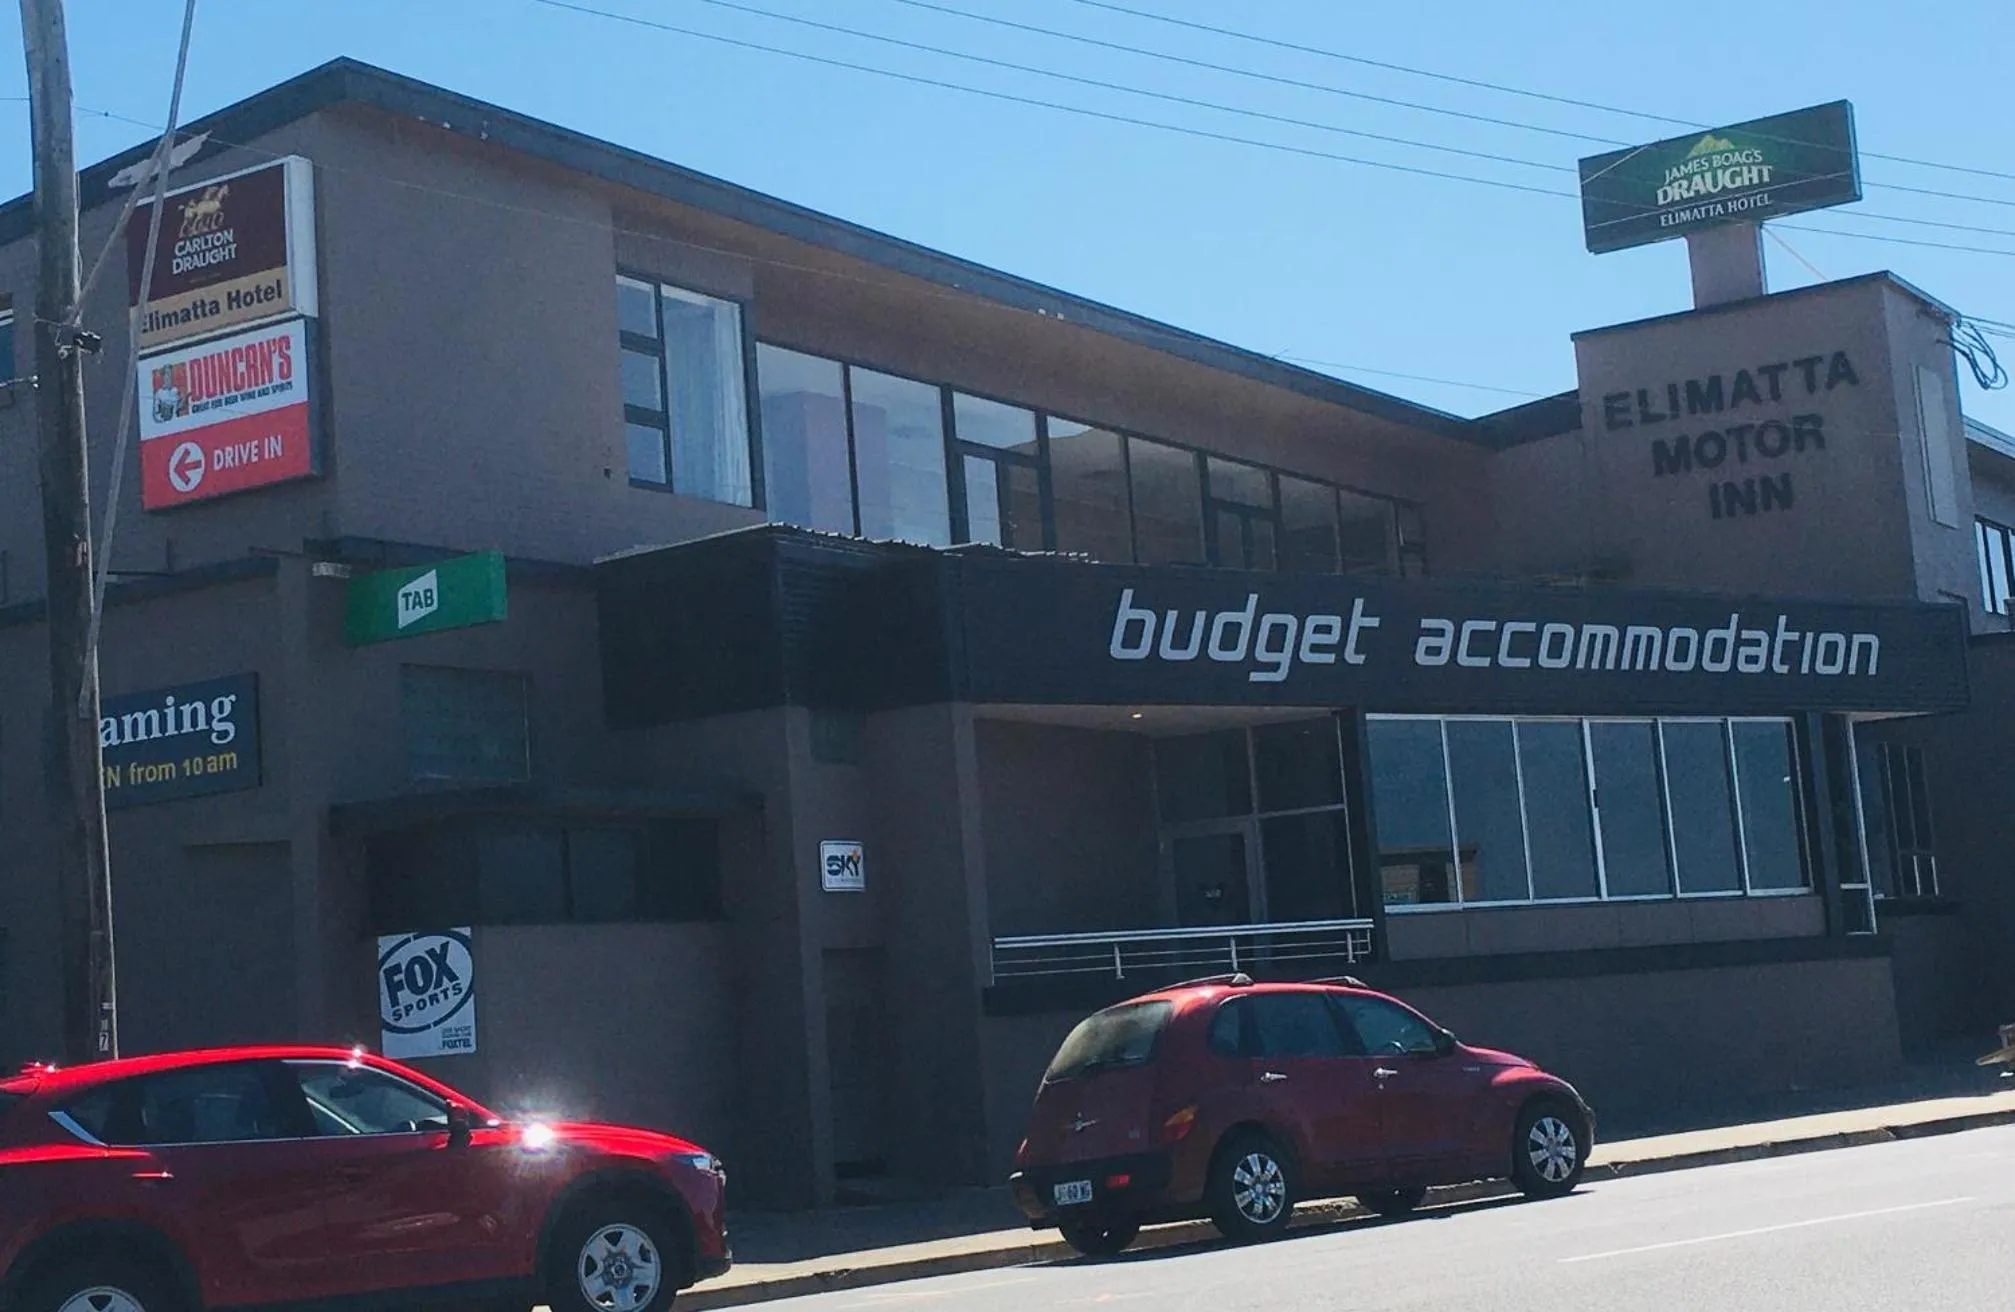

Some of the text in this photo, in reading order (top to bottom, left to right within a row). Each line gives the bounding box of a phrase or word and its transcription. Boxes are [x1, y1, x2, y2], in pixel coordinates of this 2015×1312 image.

[1656, 165, 1772, 205] DRAUGHT
[1664, 148, 1762, 185] JAMES BOAG'S
[1660, 193, 1772, 227] ELIMATTA HOTEL
[172, 243, 238, 275] DRAUGHT
[174, 228, 234, 256] CARLTON
[226, 279, 282, 311] Hotel
[188, 335, 292, 403] DUNCAN'S
[1603, 351, 1860, 431] ELIMATTA
[213, 435, 282, 471] DRIVE IN
[1652, 413, 1826, 477] MOTOR
[1709, 472, 1796, 520] INN
[401, 588, 435, 611] TAB
[1110, 588, 1880, 682] budget accommodation
[102, 764, 121, 789] N
[129, 761, 176, 785] from
[382, 940, 460, 1009] FOX
[391, 982, 463, 1021] SPORTS
